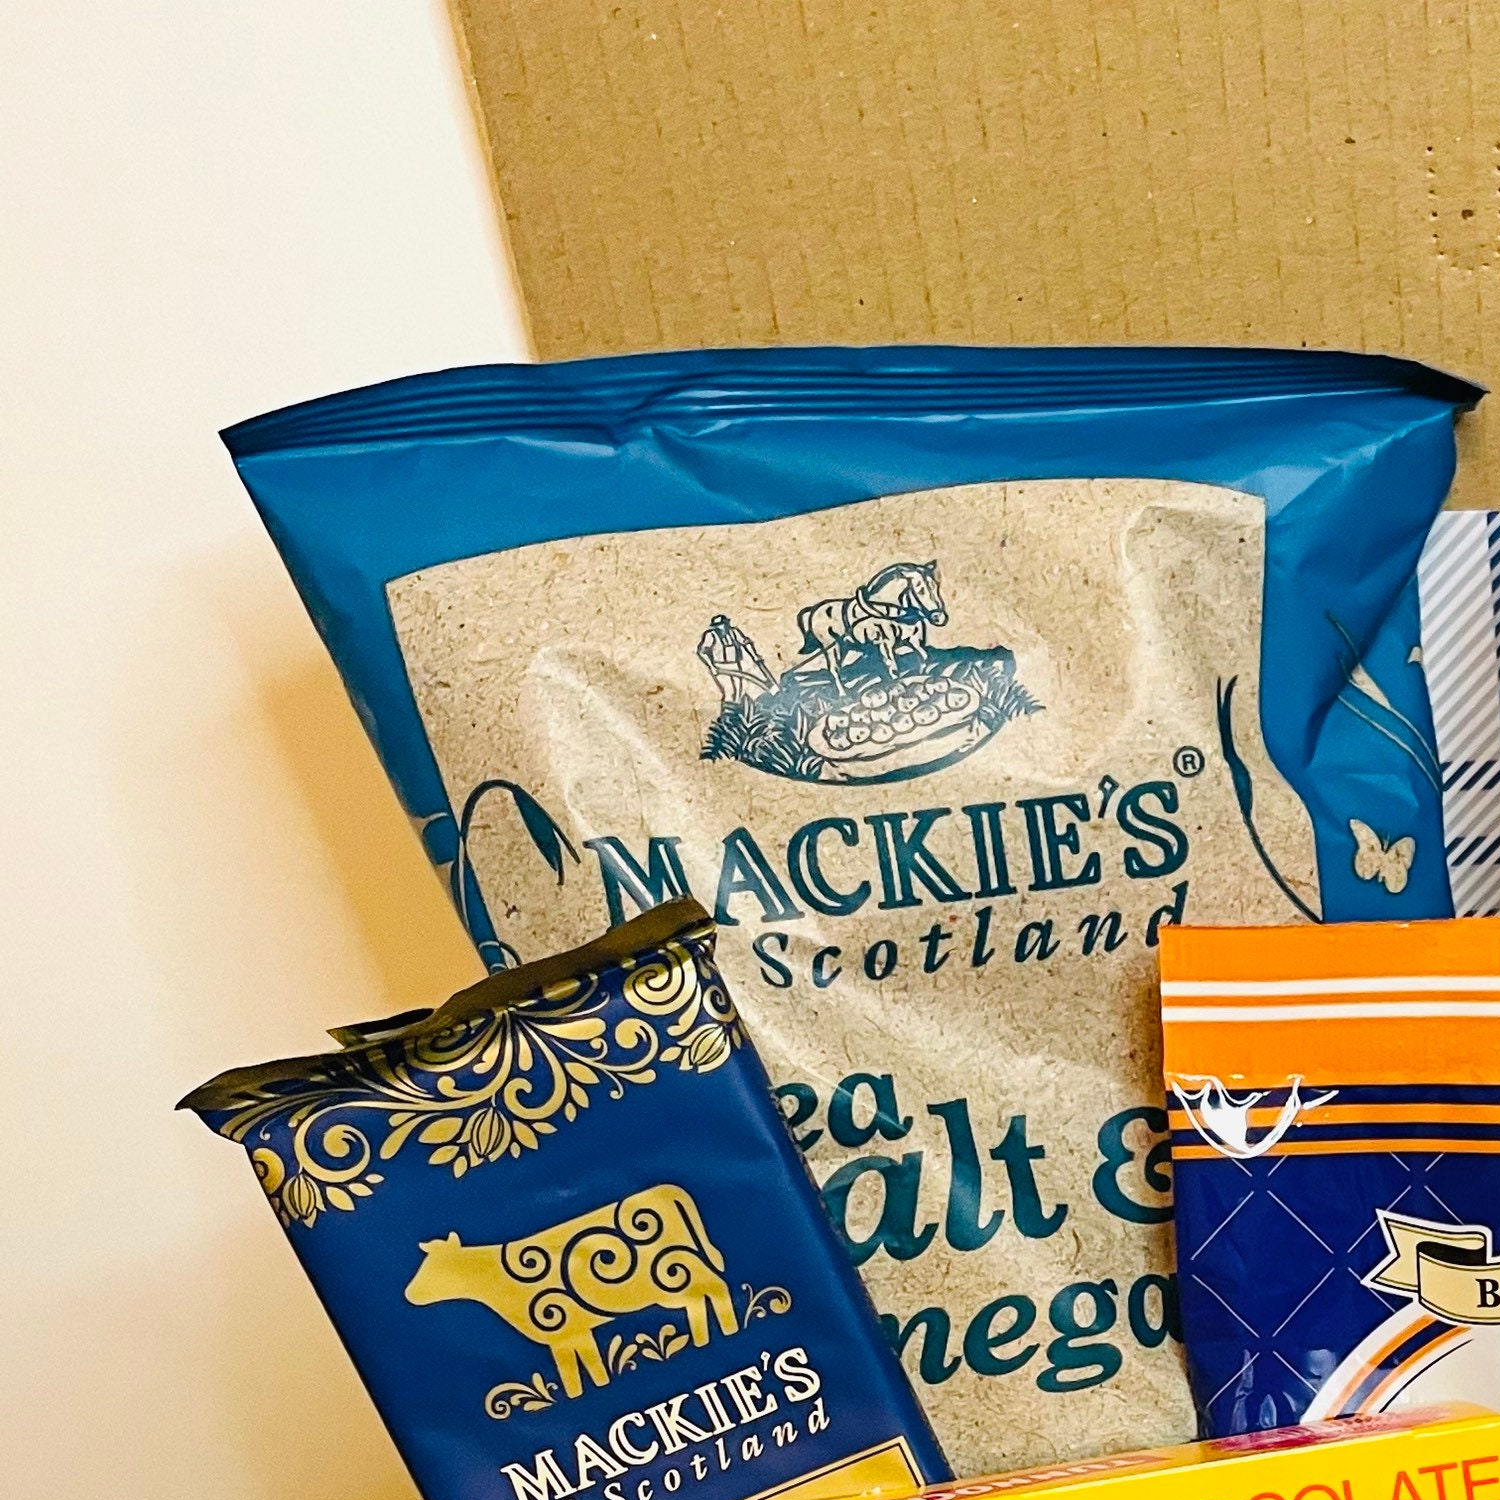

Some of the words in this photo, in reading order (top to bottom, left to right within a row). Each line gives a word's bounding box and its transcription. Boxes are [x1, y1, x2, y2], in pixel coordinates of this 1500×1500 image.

[583, 774, 1191, 930] MACKIE'S
[751, 881, 1190, 989] Scotland
[772, 1072, 914, 1150] ea
[820, 1098, 1069, 1266] alt
[1092, 1106, 1175, 1225] &
[882, 1273, 1184, 1392] nega
